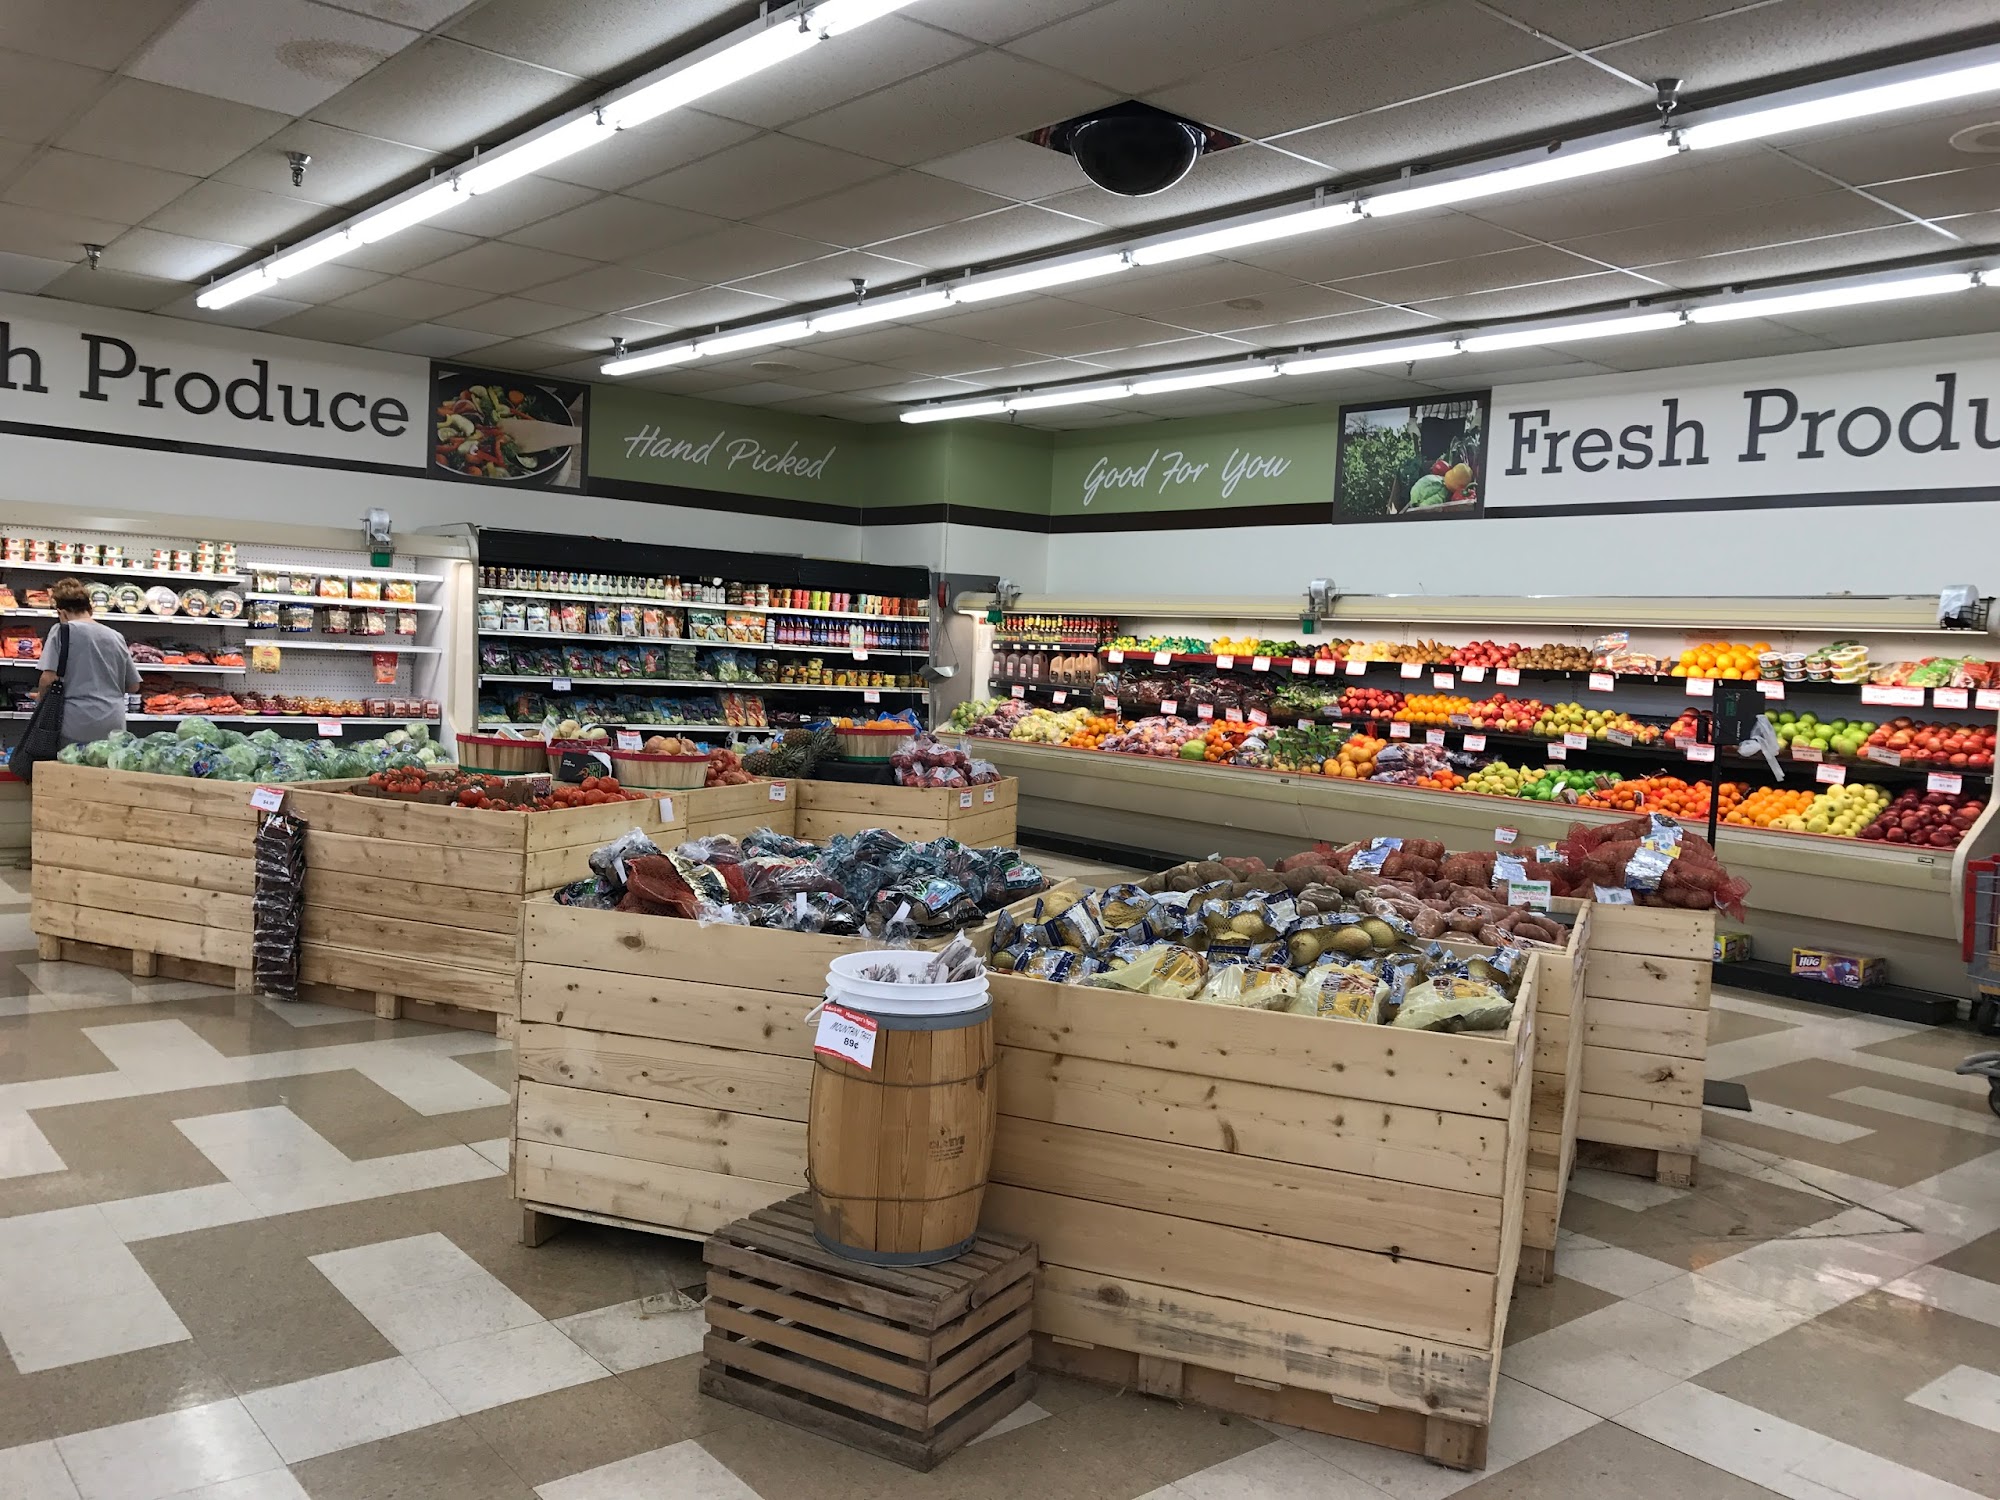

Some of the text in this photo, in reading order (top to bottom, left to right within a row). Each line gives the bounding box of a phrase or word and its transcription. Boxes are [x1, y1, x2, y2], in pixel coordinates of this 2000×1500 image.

[80, 333, 409, 437] Produce
[624, 424, 836, 480] Hand Picked
[1506, 373, 2000, 475] Fresh Produ
[1083, 448, 1292, 507] Good For You
[1799, 957, 1820, 966] HUG
[830, 1021, 860, 1037] MOUNTAIN
[843, 1037, 859, 1049] 89¢
